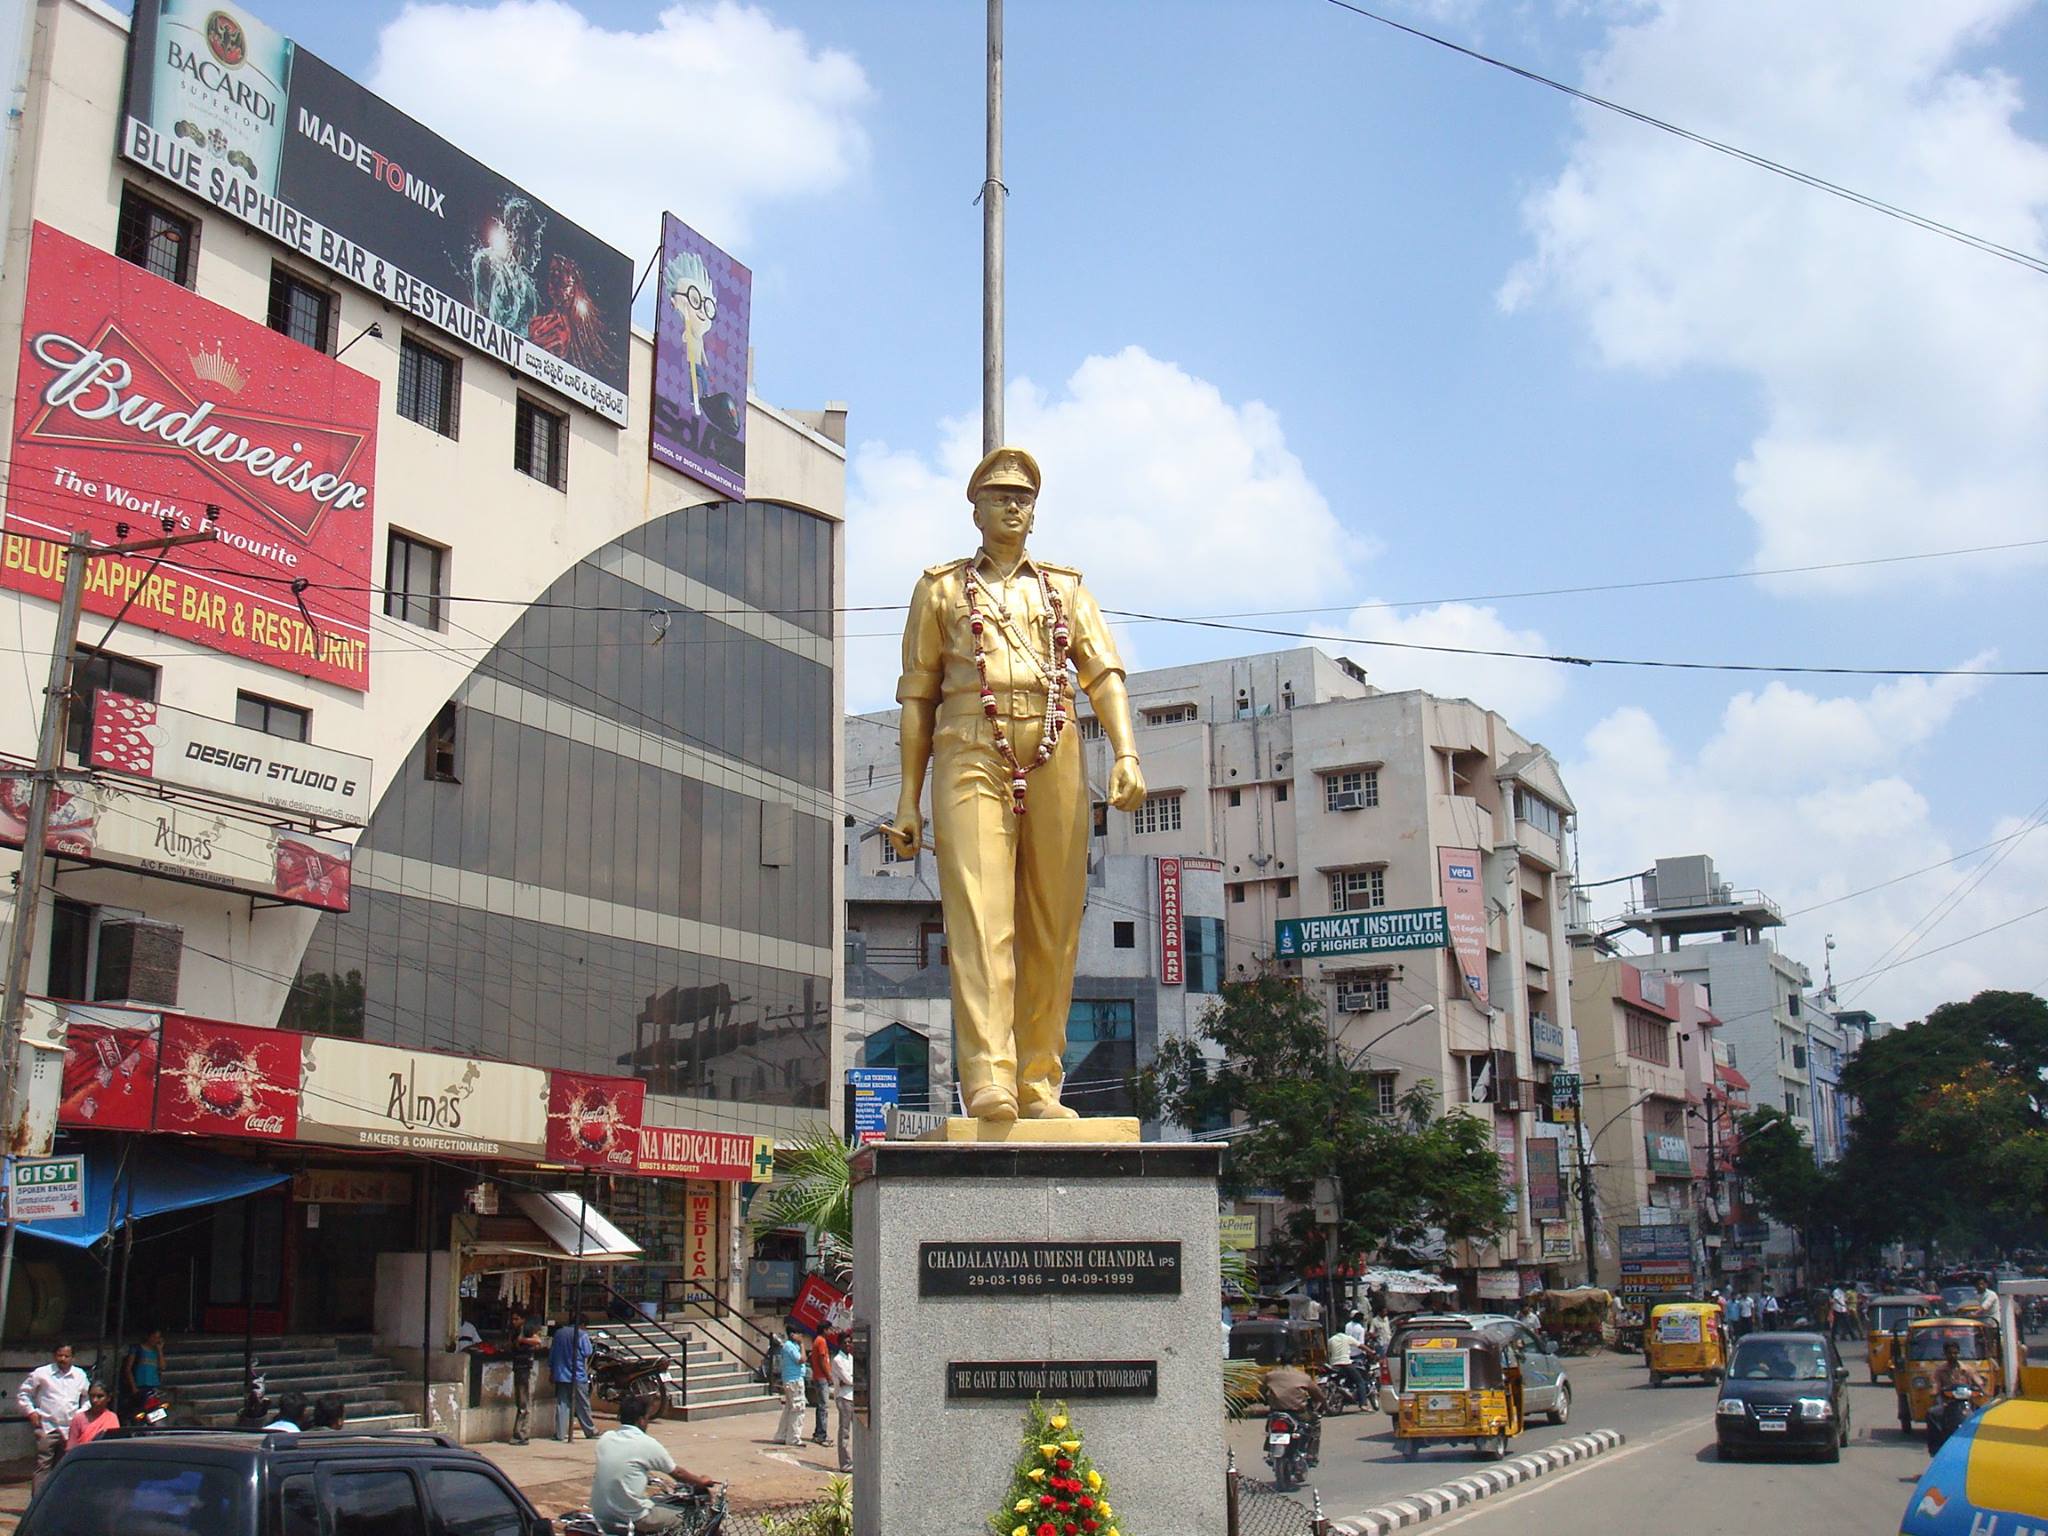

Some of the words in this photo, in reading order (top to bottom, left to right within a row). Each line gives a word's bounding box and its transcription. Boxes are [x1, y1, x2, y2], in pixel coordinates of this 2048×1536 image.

[168, 40, 276, 127] BACARDI
[180, 80, 260, 133] SUPERIOR
[133, 122, 202, 195] BLUE
[209, 167, 314, 253] SAPHIRE
[321, 228, 366, 283] BAR
[373, 260, 387, 294] &
[395, 270, 524, 367] RESTAURANT
[35, 334, 366, 509] Budweiser
[653, 442, 674, 459] SCHOOL
[683, 458, 703, 474] DIGITAL
[54, 467, 97, 497] The
[105, 484, 191, 529] World's
[5, 535, 69, 583] BLUE
[182, 584, 227, 633] BAR
[232, 602, 245, 637] &
[267, 762, 338, 793] STUDIO
[342, 781, 357, 797] 6
[267, 796, 362, 823] www.designstudio6.com
[155, 808, 212, 860] Almas
[158, 862, 187, 877] Family
[189, 869, 235, 886] Restaurant
[1451, 867, 1473, 878] veta
[1164, 878, 1178, 946] MAHANAGAR
[1301, 918, 1360, 939] VENKAT
[1364, 911, 1443, 935] INSTITUTE
[1302, 942, 1317, 953] OF
[1321, 937, 1368, 951] HIGHER
[1371, 932, 1443, 947] EDUCATION
[1167, 951, 1178, 981] BANK
[386, 1058, 461, 1130] Almas
[359, 1132, 401, 1146] BAKERS
[402, 1136, 410, 1147] &
[412, 1136, 500, 1154] CONFECTIONARIES
[663, 1133, 718, 1165] MEDICAL
[721, 1137, 751, 1167] HALL
[18, 1164, 74, 1183] GIST
[18, 1186, 46, 1194] SPOKEN
[928, 1251, 1029, 1269] CHADALAVADA
[1034, 1250, 1083, 1268] UMESH
[1088, 1250, 1156, 1267] CHANDRA
[1159, 1257, 1175, 1267] IPS
[969, 1274, 1042, 1286] 29-03-1966
[1061, 1273, 1135, 1286] 04-09-1999
[974, 1371, 998, 1389] GAVE
[999, 1371, 1016, 1388] HIS
[1018, 1371, 1047, 1388] TODAY
[1049, 1371, 1068, 1388] FOR
[1070, 1370, 1094, 1388] YOUR
